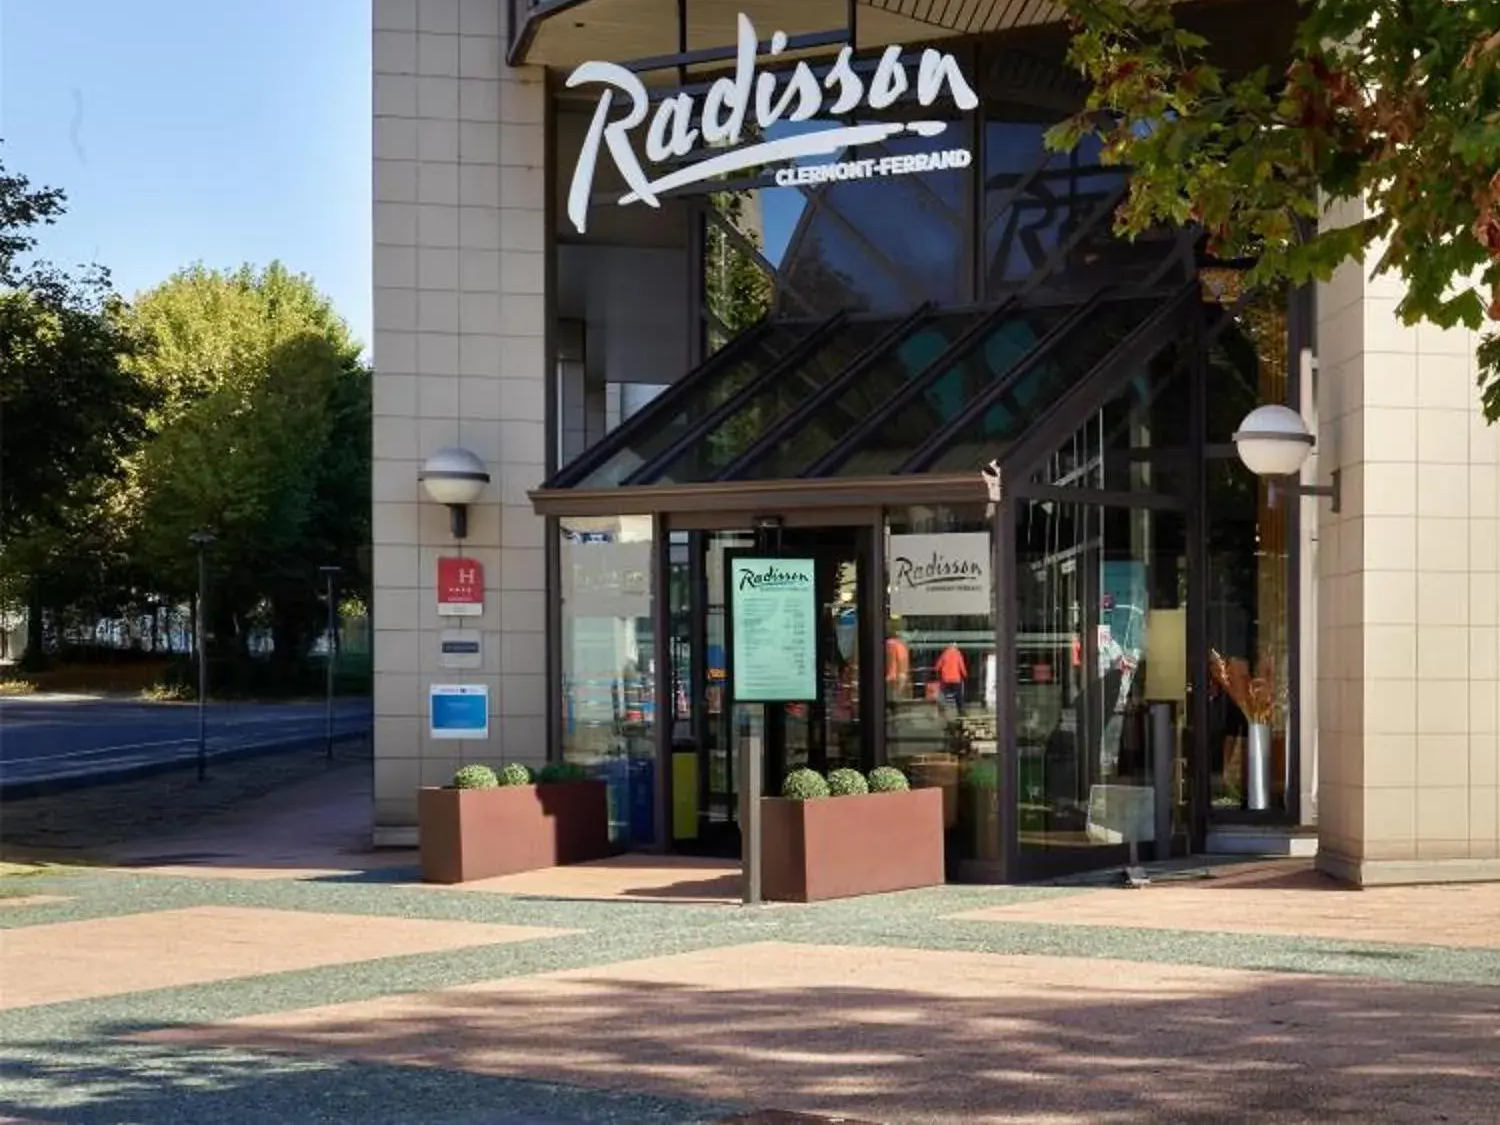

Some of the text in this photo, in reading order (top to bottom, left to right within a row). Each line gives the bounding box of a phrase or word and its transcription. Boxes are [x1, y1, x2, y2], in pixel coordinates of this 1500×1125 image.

[565, 12, 979, 234] Radisson
[775, 149, 972, 187] CLERMONT-FERRAND
[458, 567, 476, 585] H
[738, 565, 809, 591] Radisson
[895, 550, 982, 589] Radisson
